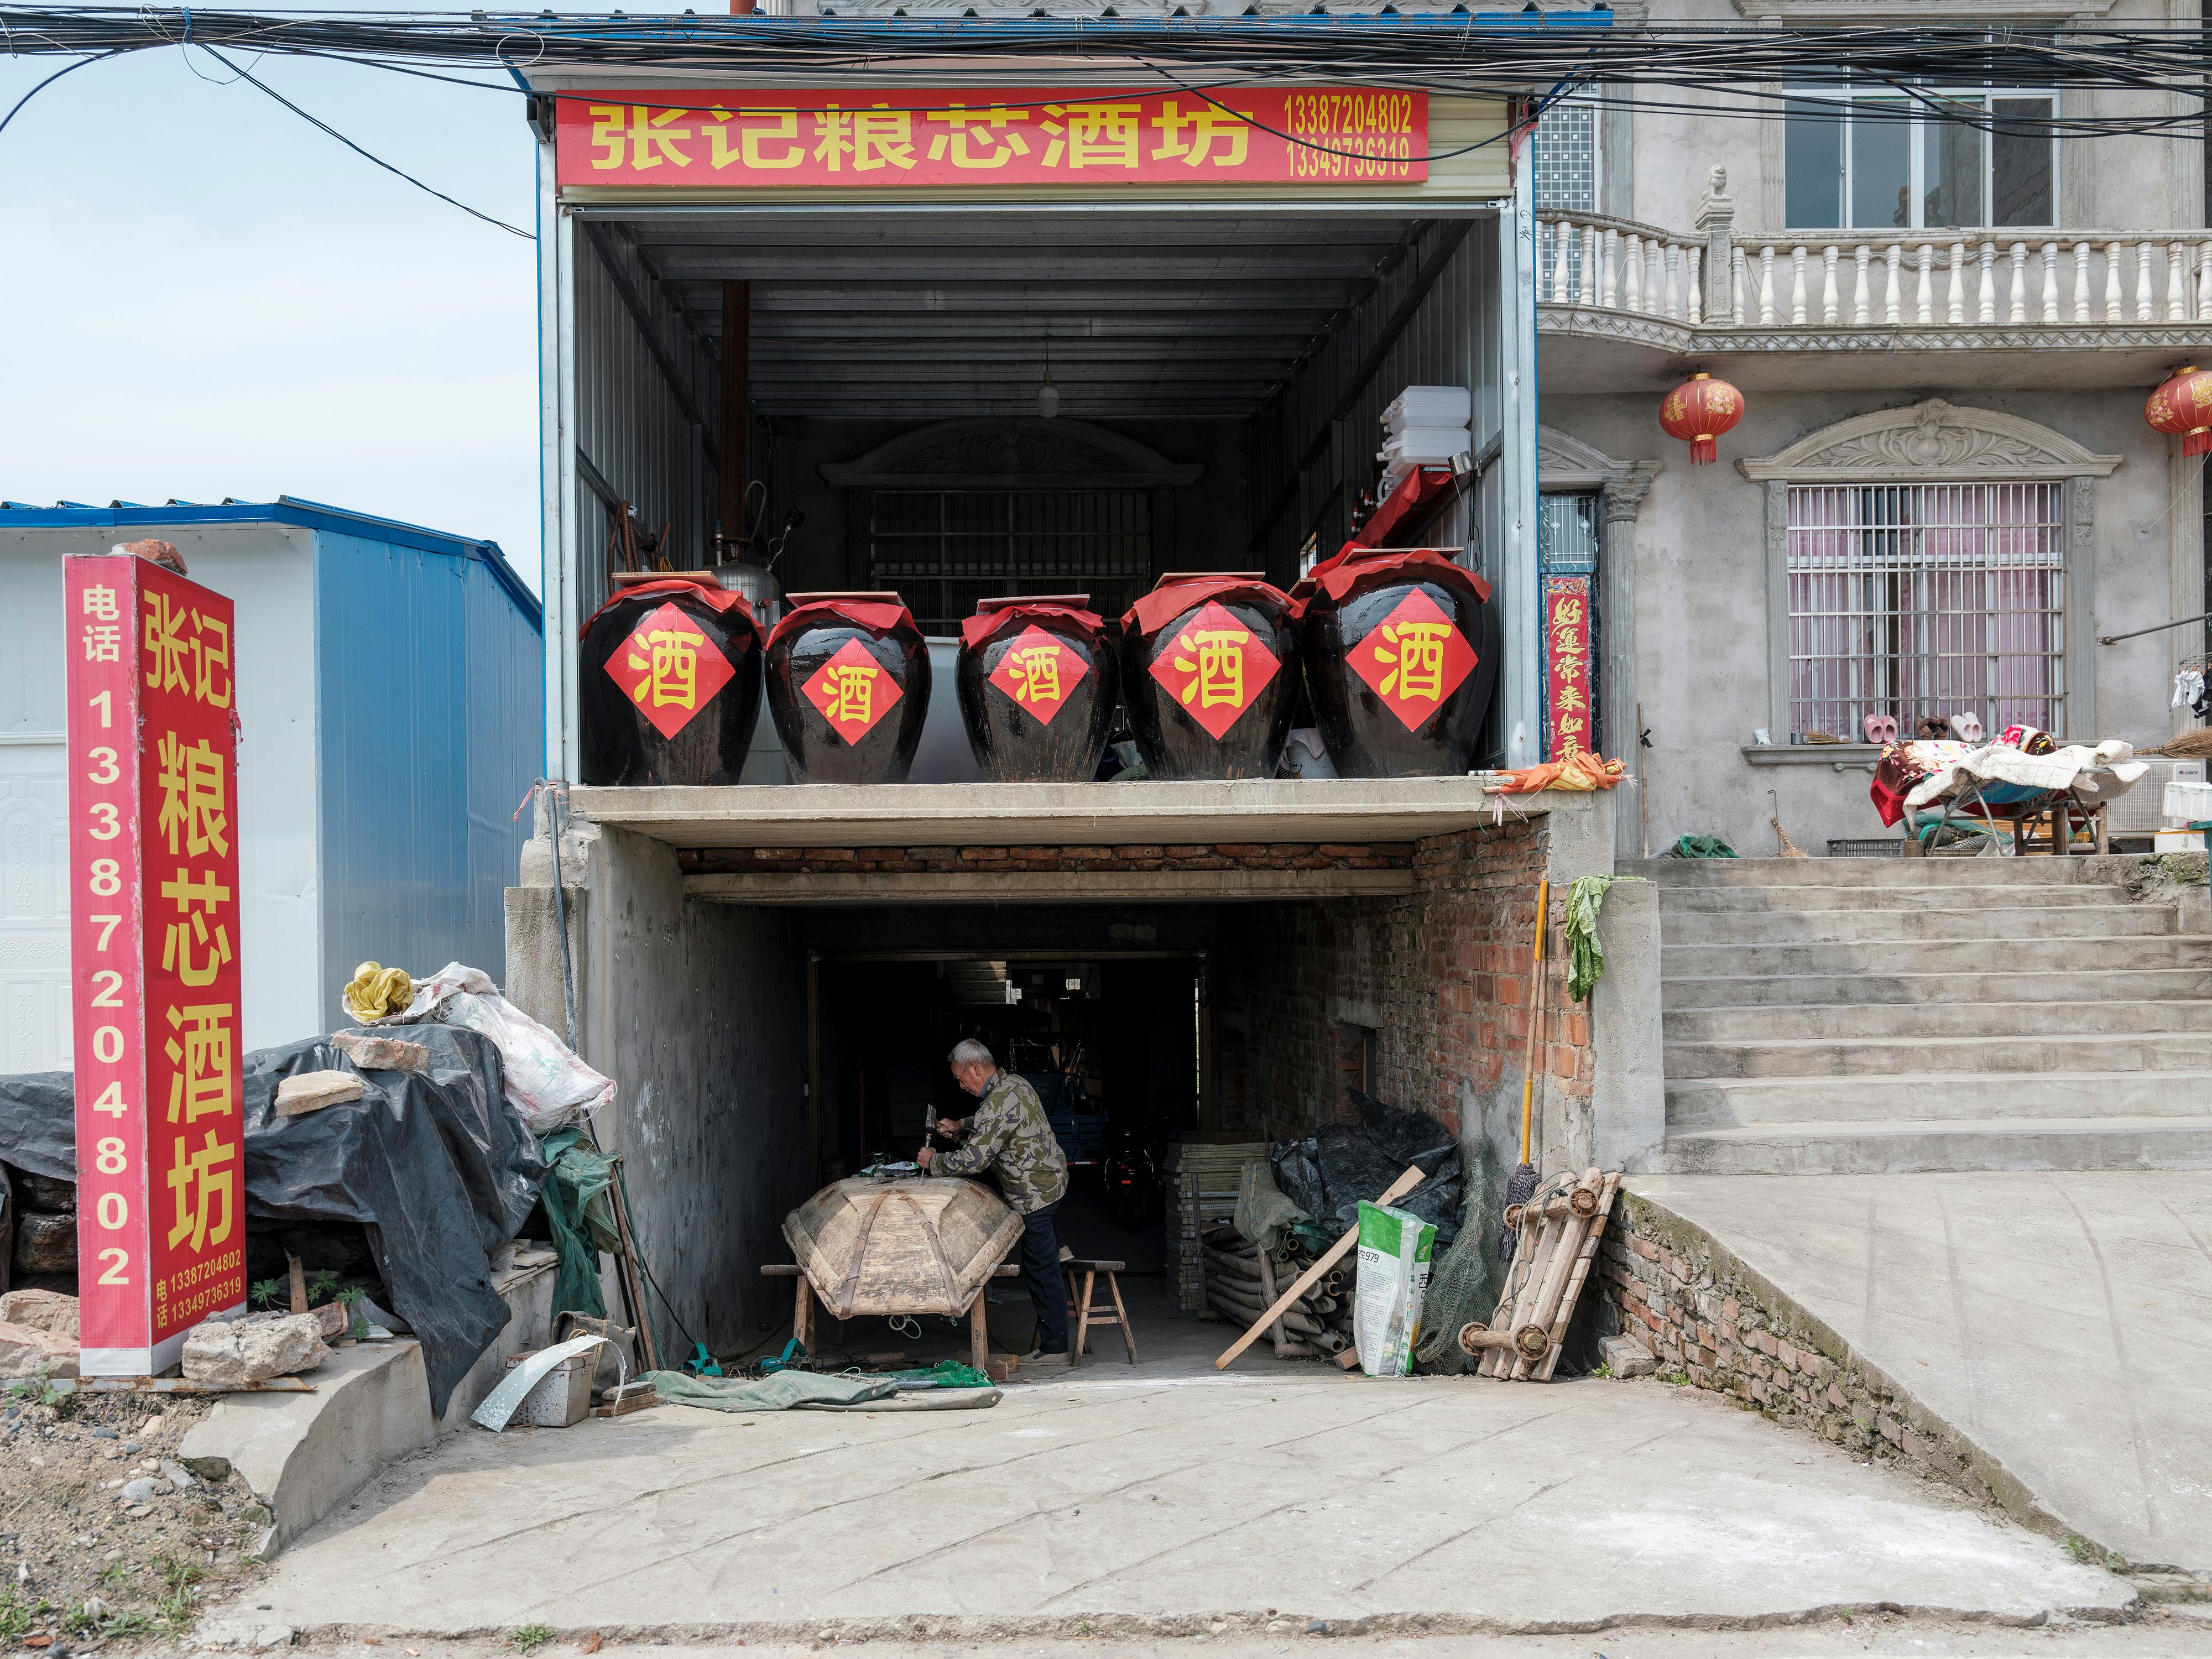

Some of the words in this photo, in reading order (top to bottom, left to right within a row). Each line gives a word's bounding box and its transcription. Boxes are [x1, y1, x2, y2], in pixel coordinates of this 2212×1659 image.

[589, 101, 1253, 171] 张记粮芯酒坊
[1284, 95, 1411, 134] 13387204802
[1286, 137, 1409, 177] 13349736319
[83, 584, 121, 662] 电话
[144, 589, 231, 708] 张记
[628, 629, 704, 710] 酒
[822, 665, 878, 724] 酒
[1008, 646, 1061, 703] 酒
[1174, 630, 1249, 708] 酒
[1374, 621, 1452, 702] 酒
[88, 691, 129, 1285] 13387204802
[158, 731, 235, 1254] 粮芯酒坊
[156, 1279, 168, 1329] 电话
[170, 1249, 241, 1293] 13387204802
[172, 1276, 241, 1322] 13349736319
